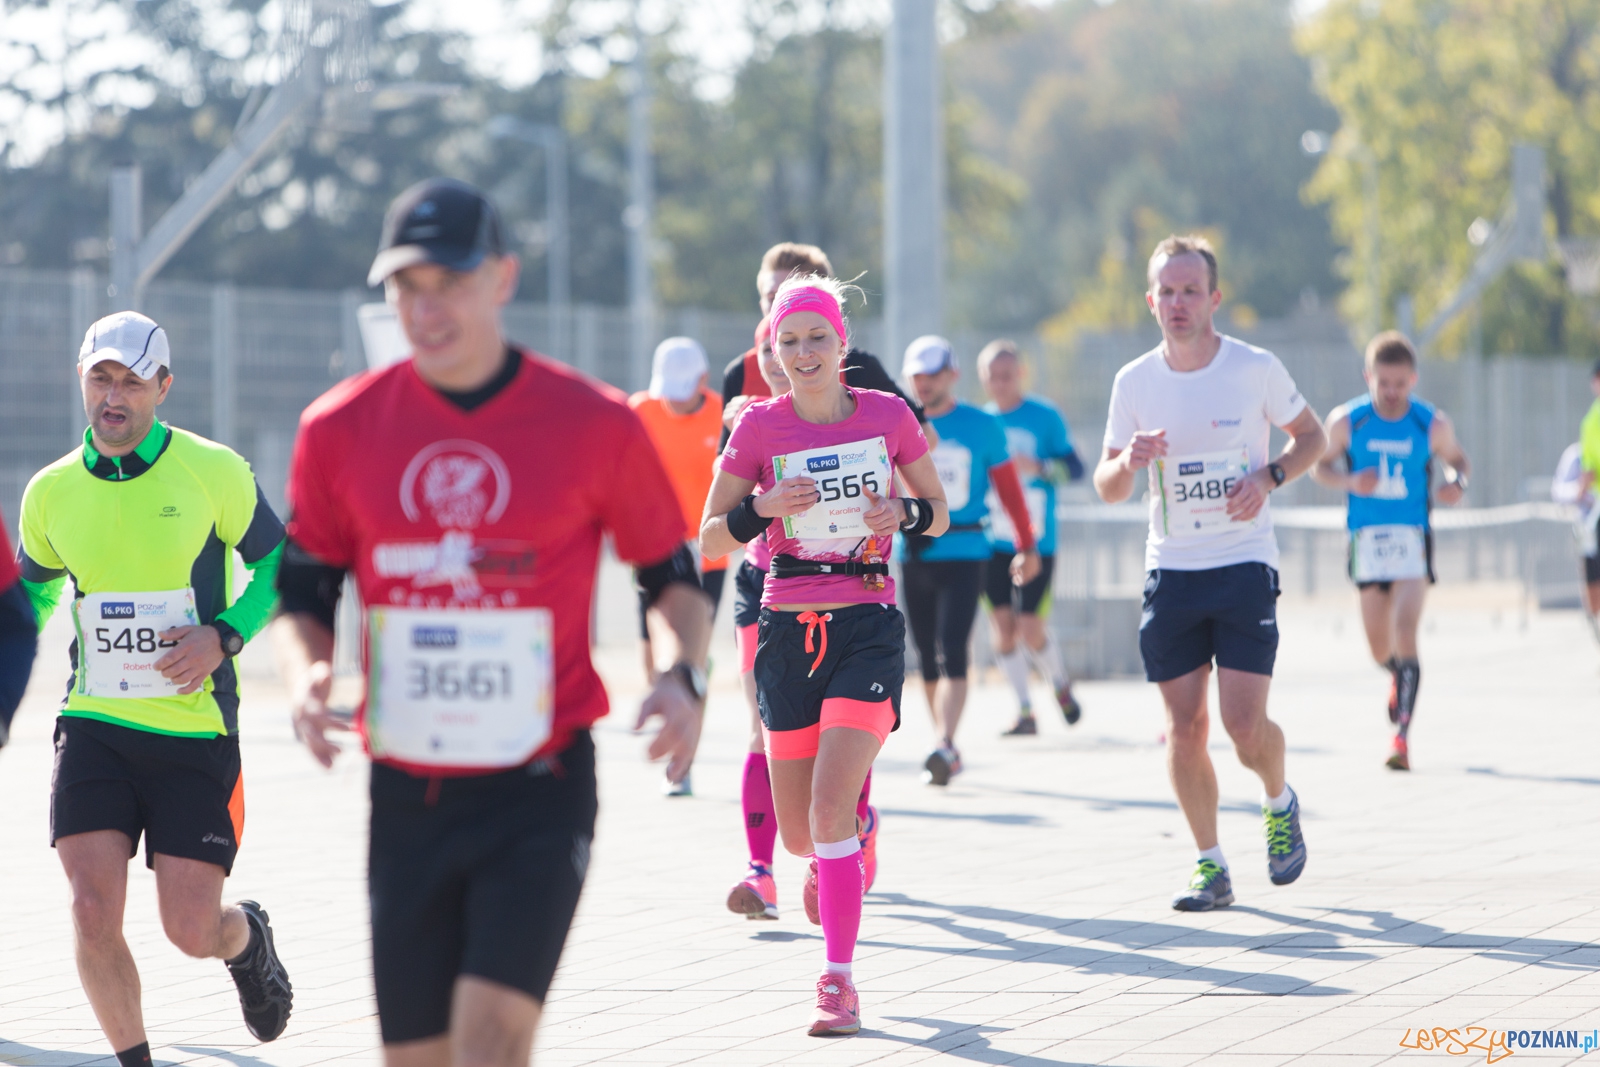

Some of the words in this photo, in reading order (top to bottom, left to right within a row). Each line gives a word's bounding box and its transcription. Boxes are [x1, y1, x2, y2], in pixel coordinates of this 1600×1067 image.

[829, 506, 861, 516] Karolina
[123, 663, 152, 671] Robert
[405, 659, 513, 701] 3661
